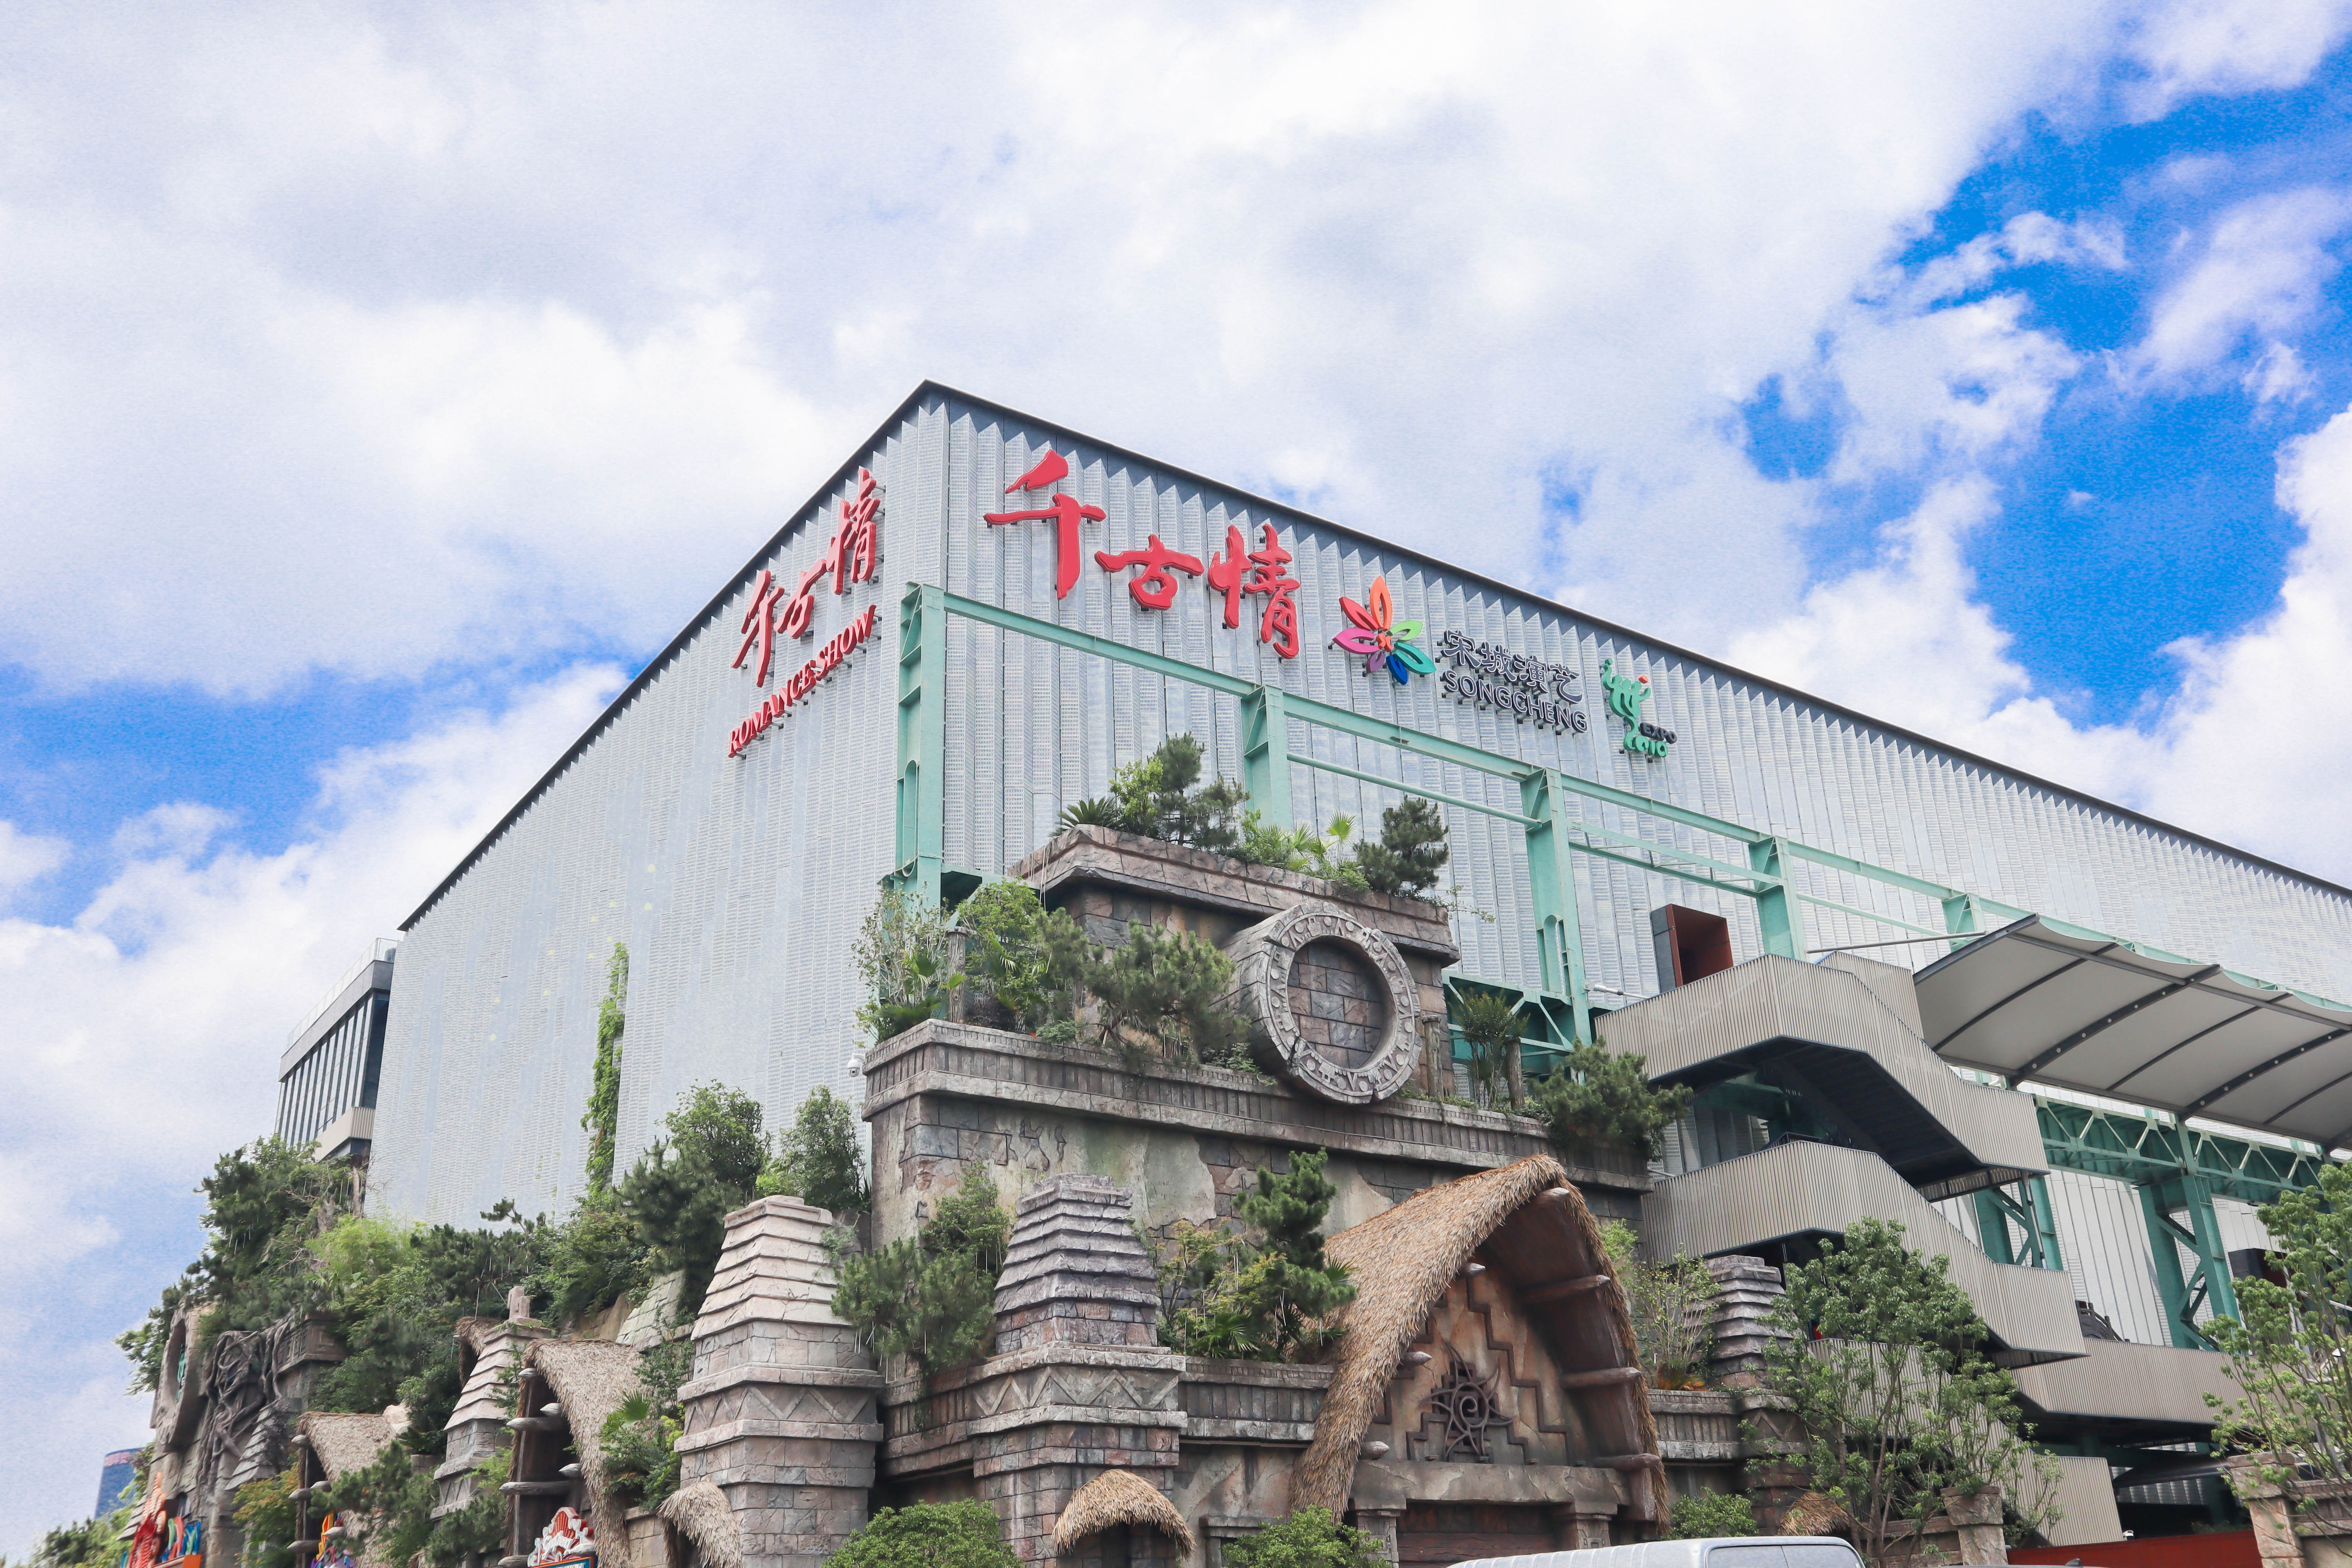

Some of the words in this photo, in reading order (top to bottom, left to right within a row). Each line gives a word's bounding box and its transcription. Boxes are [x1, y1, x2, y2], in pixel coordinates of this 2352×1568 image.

[731, 468, 880, 688] 千古情
[983, 449, 1300, 659] 千古情
[728, 659, 816, 758] ROMANCE
[816, 604, 877, 681] SHOW
[1442, 630, 1583, 704] 宋城演艺
[1444, 669, 1588, 733] SONGCHENG
[1640, 722, 1677, 744] EXPO
